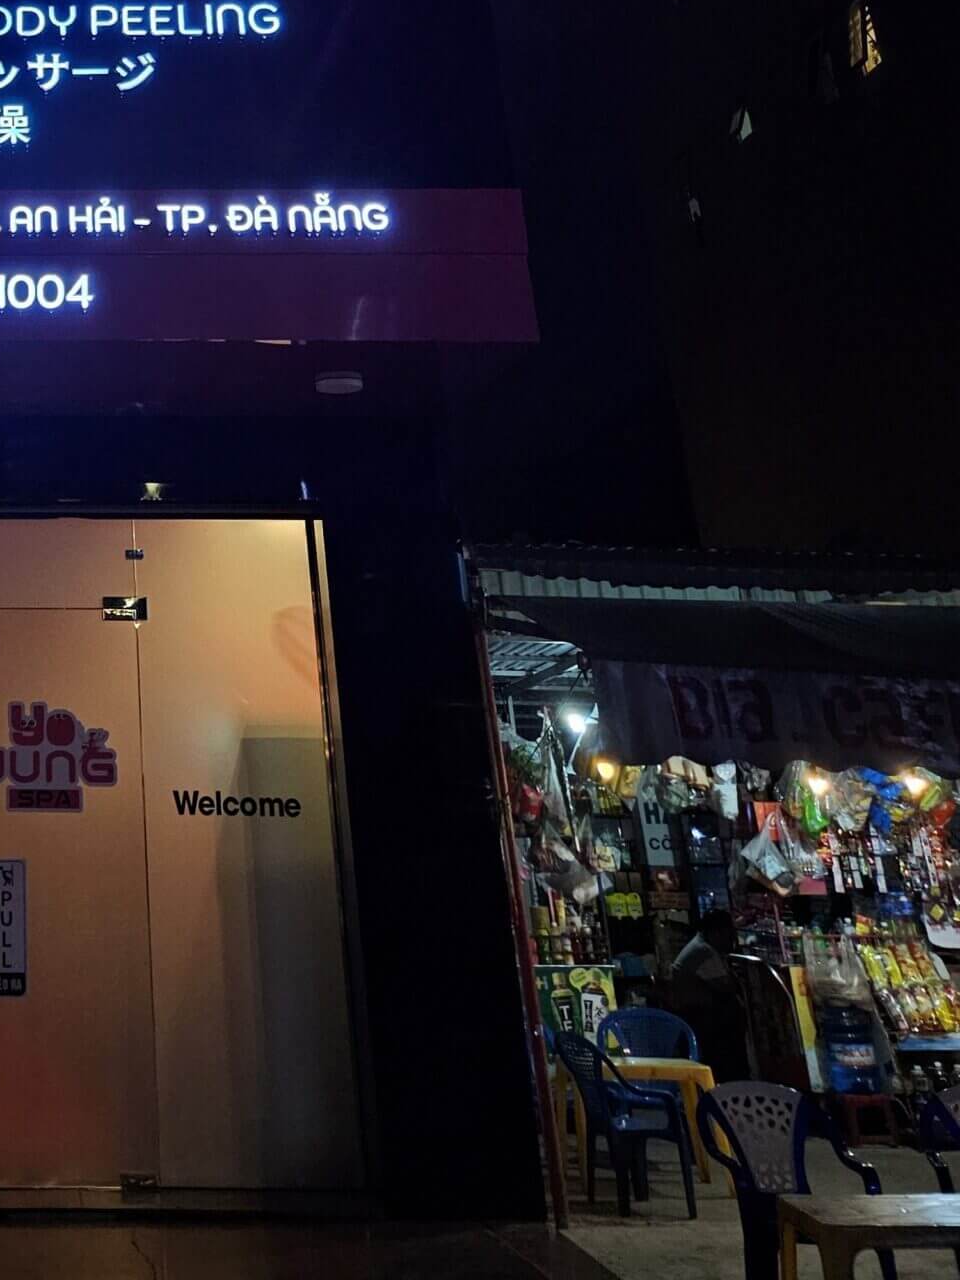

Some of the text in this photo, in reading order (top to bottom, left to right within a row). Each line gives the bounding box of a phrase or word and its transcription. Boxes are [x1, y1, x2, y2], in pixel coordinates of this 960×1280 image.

[90, 3, 282, 38] PEELING
[68, 197, 126, 233] HẢI
[225, 195, 279, 232] ĐÀ
[17, 790, 71, 808] SPA
[172, 790, 301, 819] Welcome
[0, 890, 13, 969] PULL
